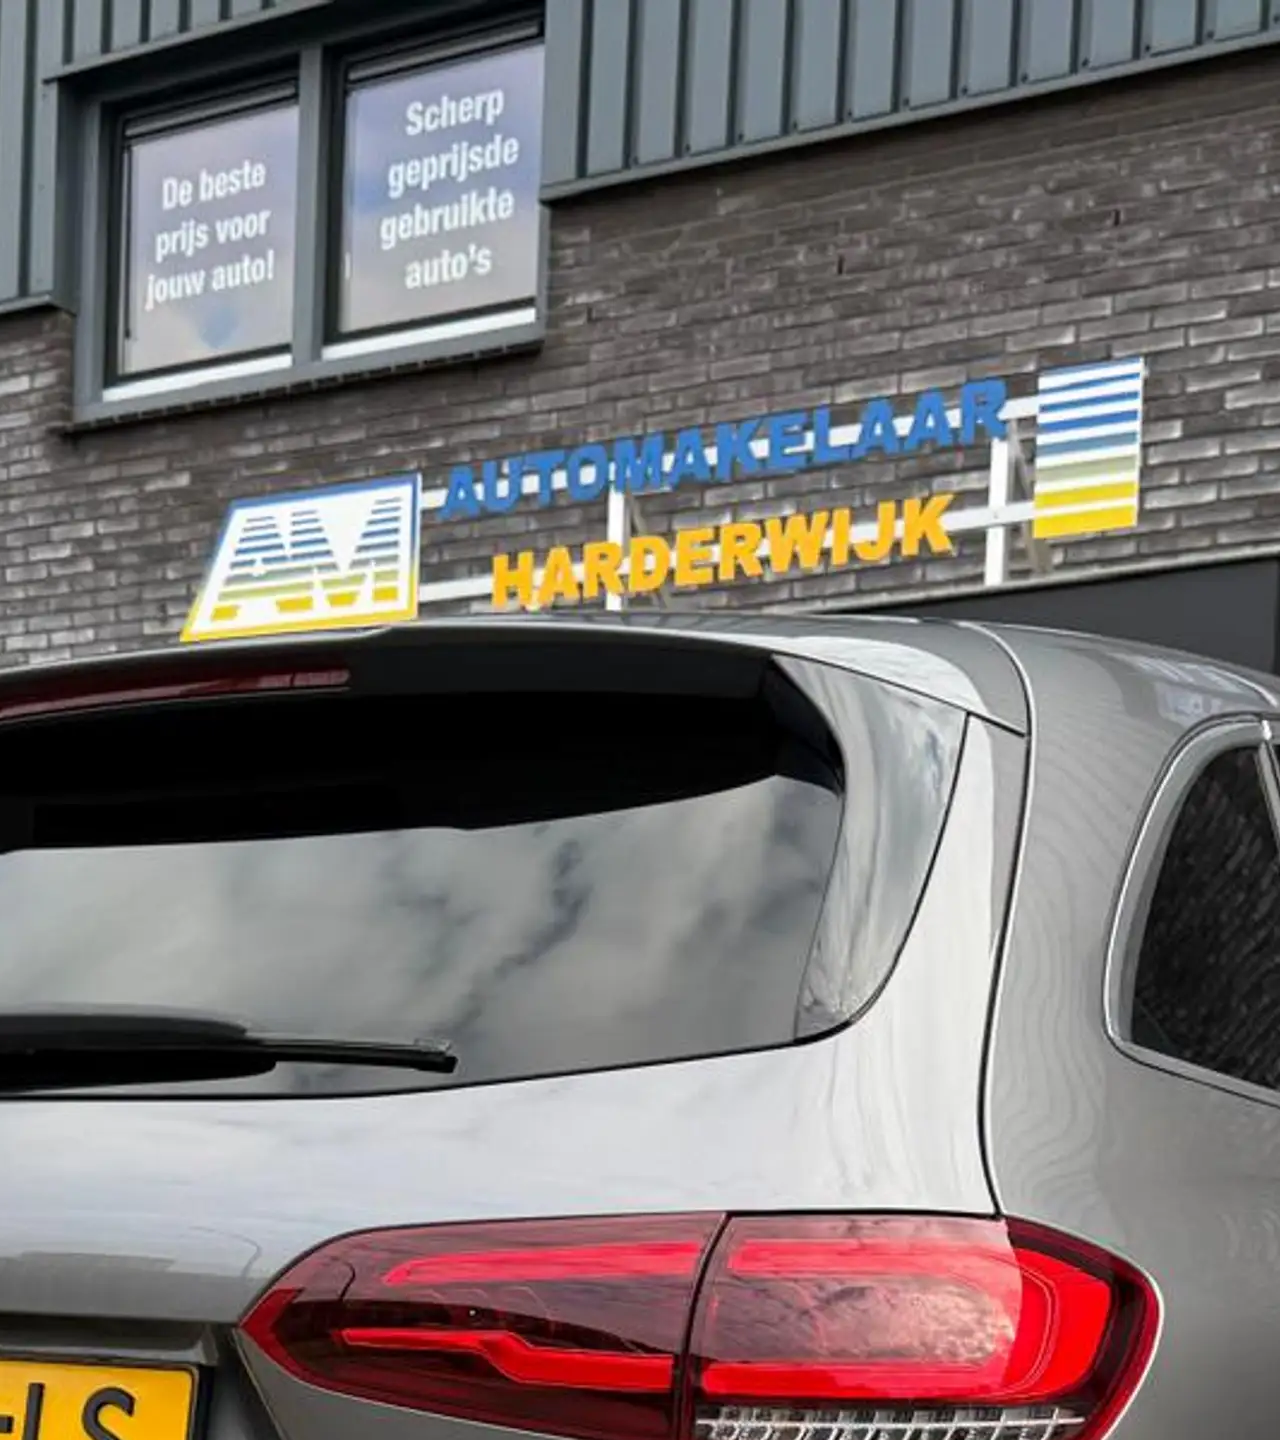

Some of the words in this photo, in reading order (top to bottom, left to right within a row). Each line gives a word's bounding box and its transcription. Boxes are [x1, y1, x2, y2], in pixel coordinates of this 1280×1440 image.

[405, 88, 505, 136] Scherp
[161, 176, 193, 211] De
[199, 160, 266, 203] beste
[387, 134, 520, 199] geprijsde
[154, 219, 209, 263] prijs
[215, 208, 272, 247] voor
[380, 188, 515, 250] gebruikte
[145, 271, 206, 311] jouw
[211, 250, 275, 292] auto!
[404, 243, 493, 290] auto's
[435, 376, 1008, 521] AUTOMAKELAAR
[491, 493, 958, 611] HARDERWIJK
